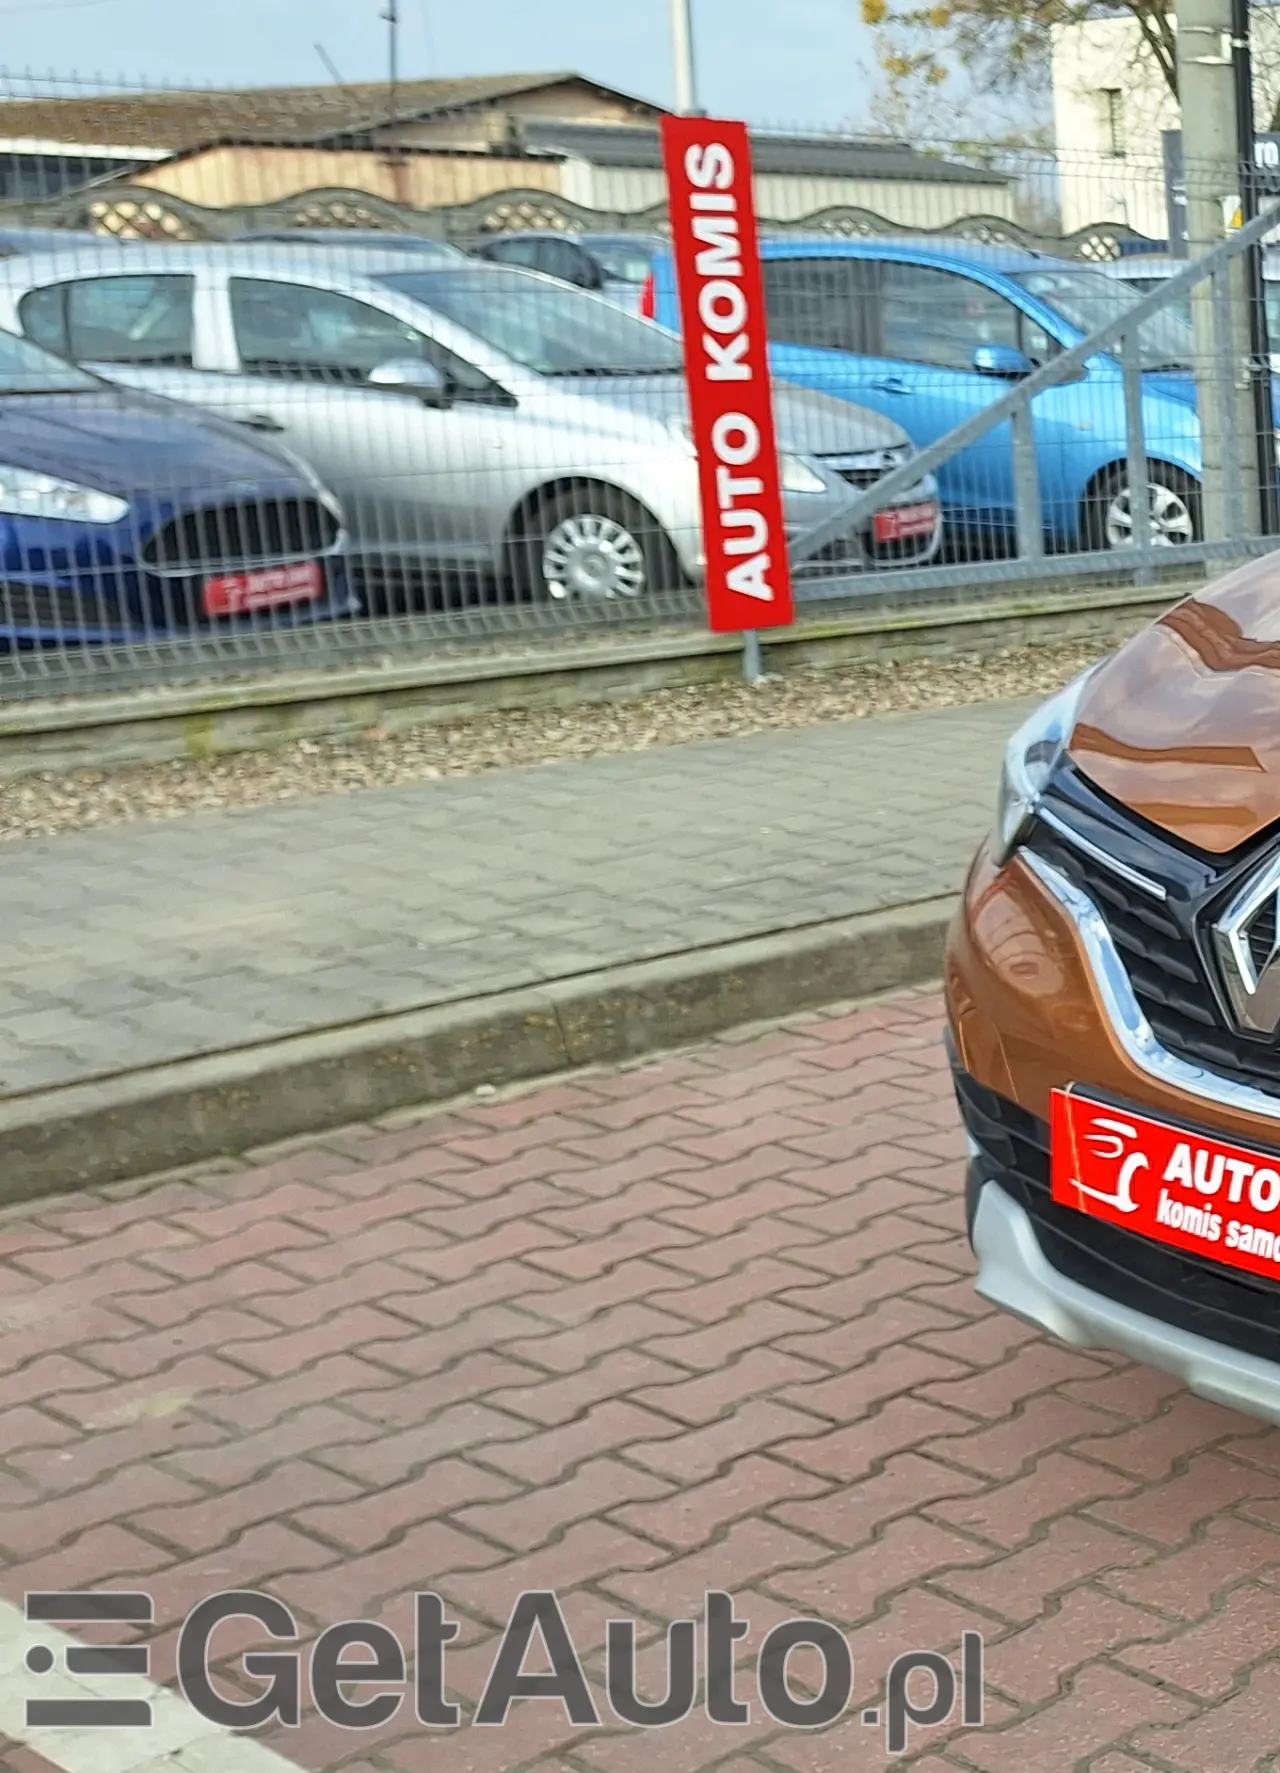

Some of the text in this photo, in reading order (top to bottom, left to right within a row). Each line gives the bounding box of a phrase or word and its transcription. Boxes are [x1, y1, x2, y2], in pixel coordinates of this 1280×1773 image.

[685, 142, 774, 602] AUTO KOMIS
[1156, 1188, 1223, 1241] komis
